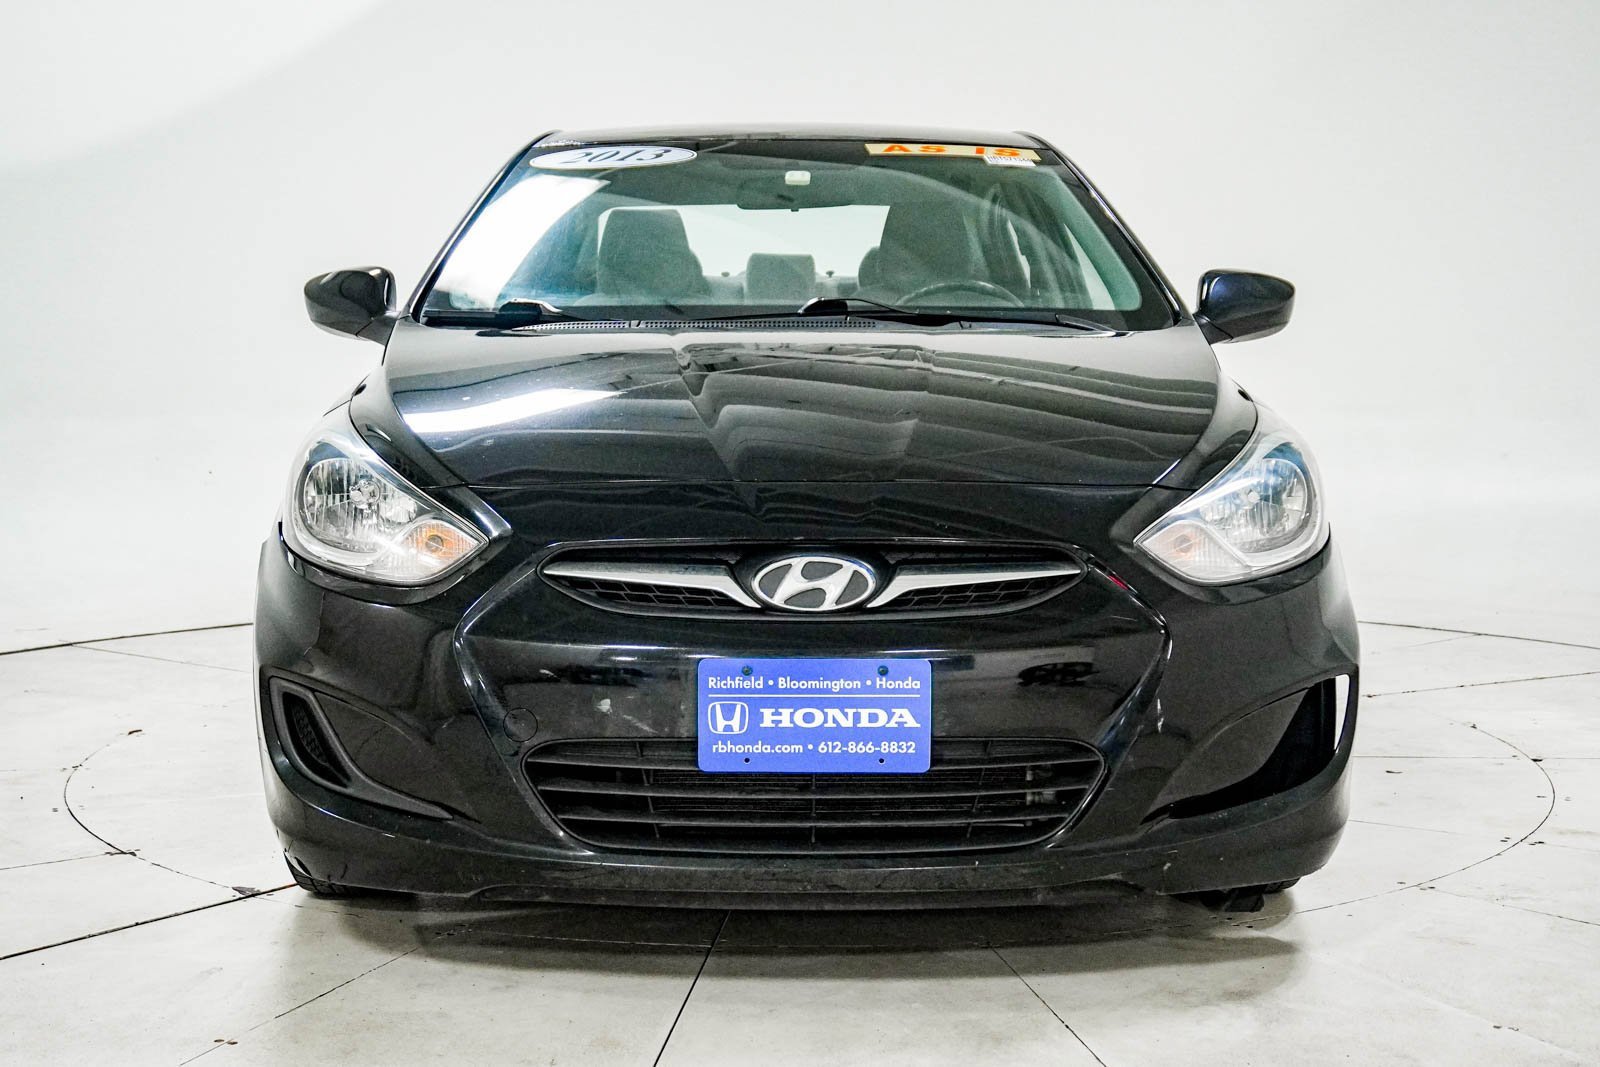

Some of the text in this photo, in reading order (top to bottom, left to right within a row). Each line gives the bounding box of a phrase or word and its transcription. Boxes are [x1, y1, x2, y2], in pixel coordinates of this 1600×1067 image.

[562, 149, 673, 164] 2013
[882, 144, 1021, 157] AS IS
[708, 676, 921, 692] Richfield Bloomington Honda
[759, 707, 921, 728] HONDA
[712, 740, 916, 754] rbhonda.com 612-866-8832
